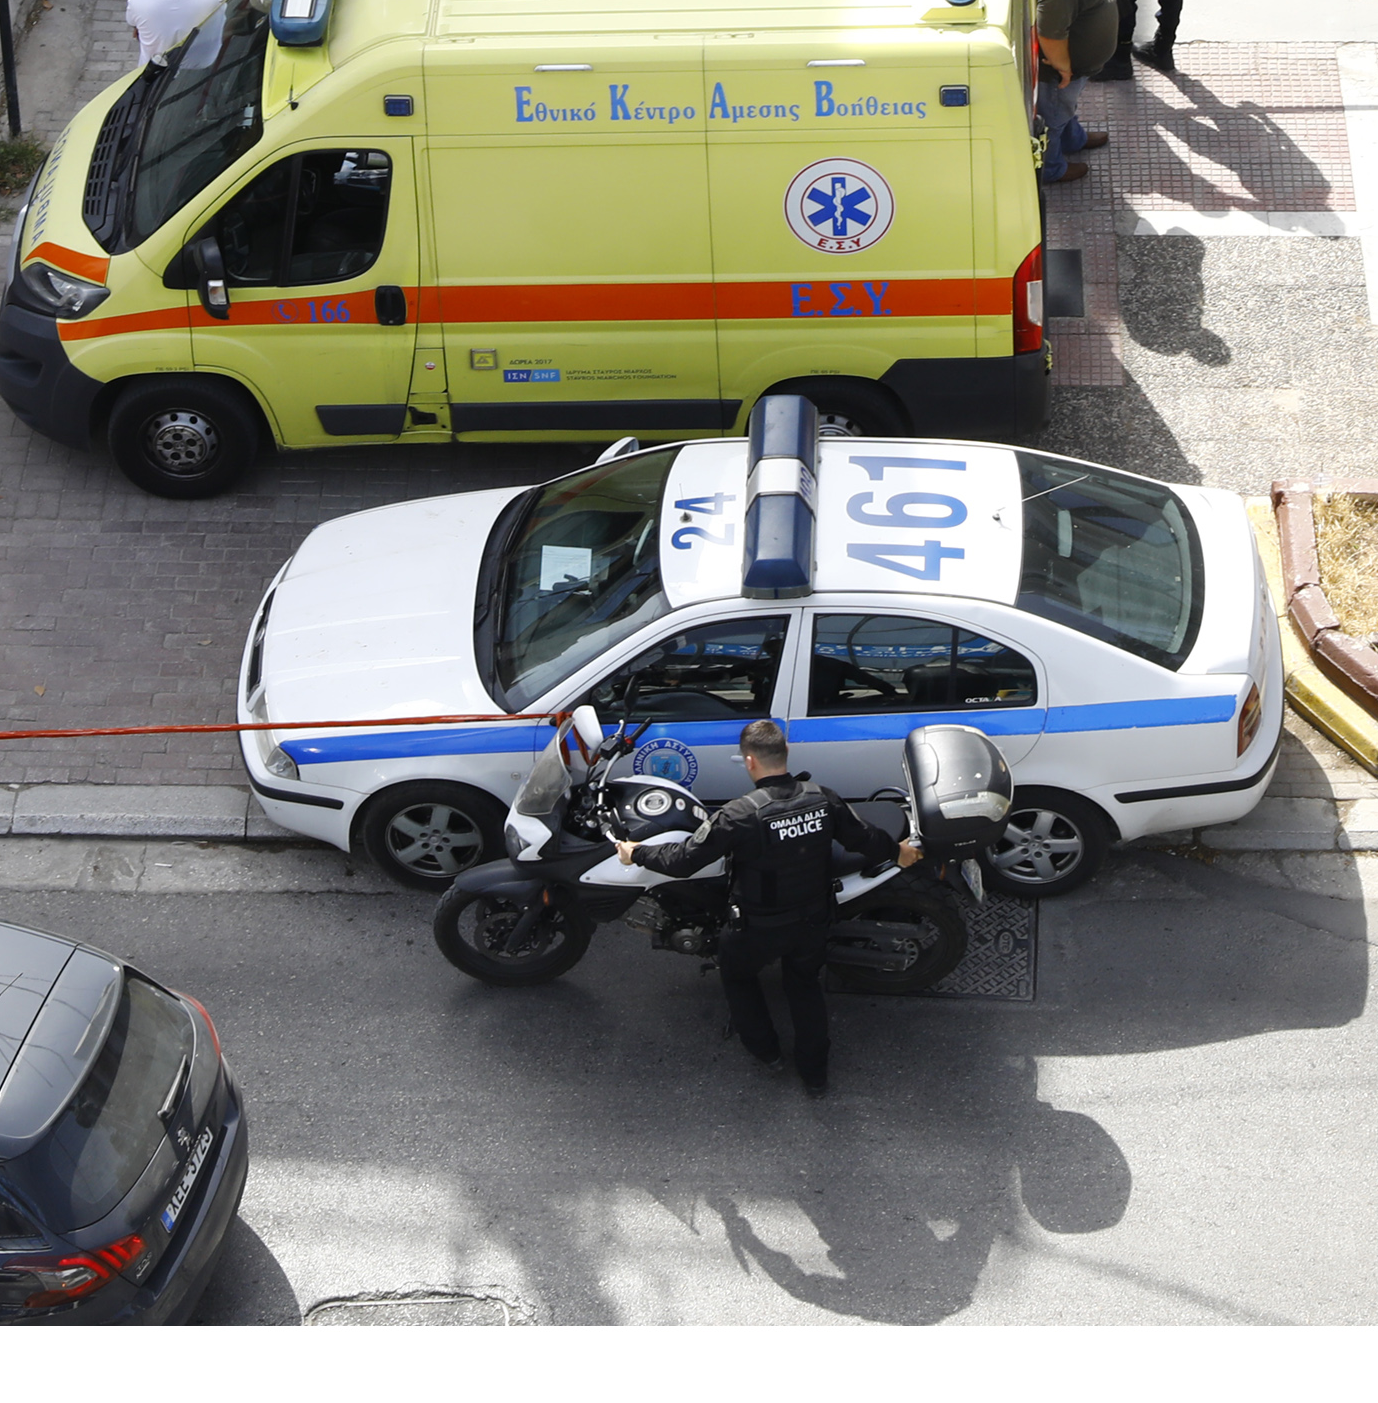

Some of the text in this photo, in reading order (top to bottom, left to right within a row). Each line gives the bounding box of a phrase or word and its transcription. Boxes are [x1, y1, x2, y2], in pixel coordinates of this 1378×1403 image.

[514, 80, 928, 124] Εθνικό Κέντρο Αμεσης Βοήθειας
[307, 300, 351, 324] 166
[790, 282, 893, 318] Ε.Σ.Υ.
[507, 372, 528, 380] ΙΣΝ
[671, 492, 737, 551] 24
[847, 455, 968, 582] 461
[664, 740, 697, 783] ΑΣΤΥΝΟΜΙΑ
[770, 815, 804, 830] ΟΜΑΔΑ
[778, 819, 823, 841] POLICE
